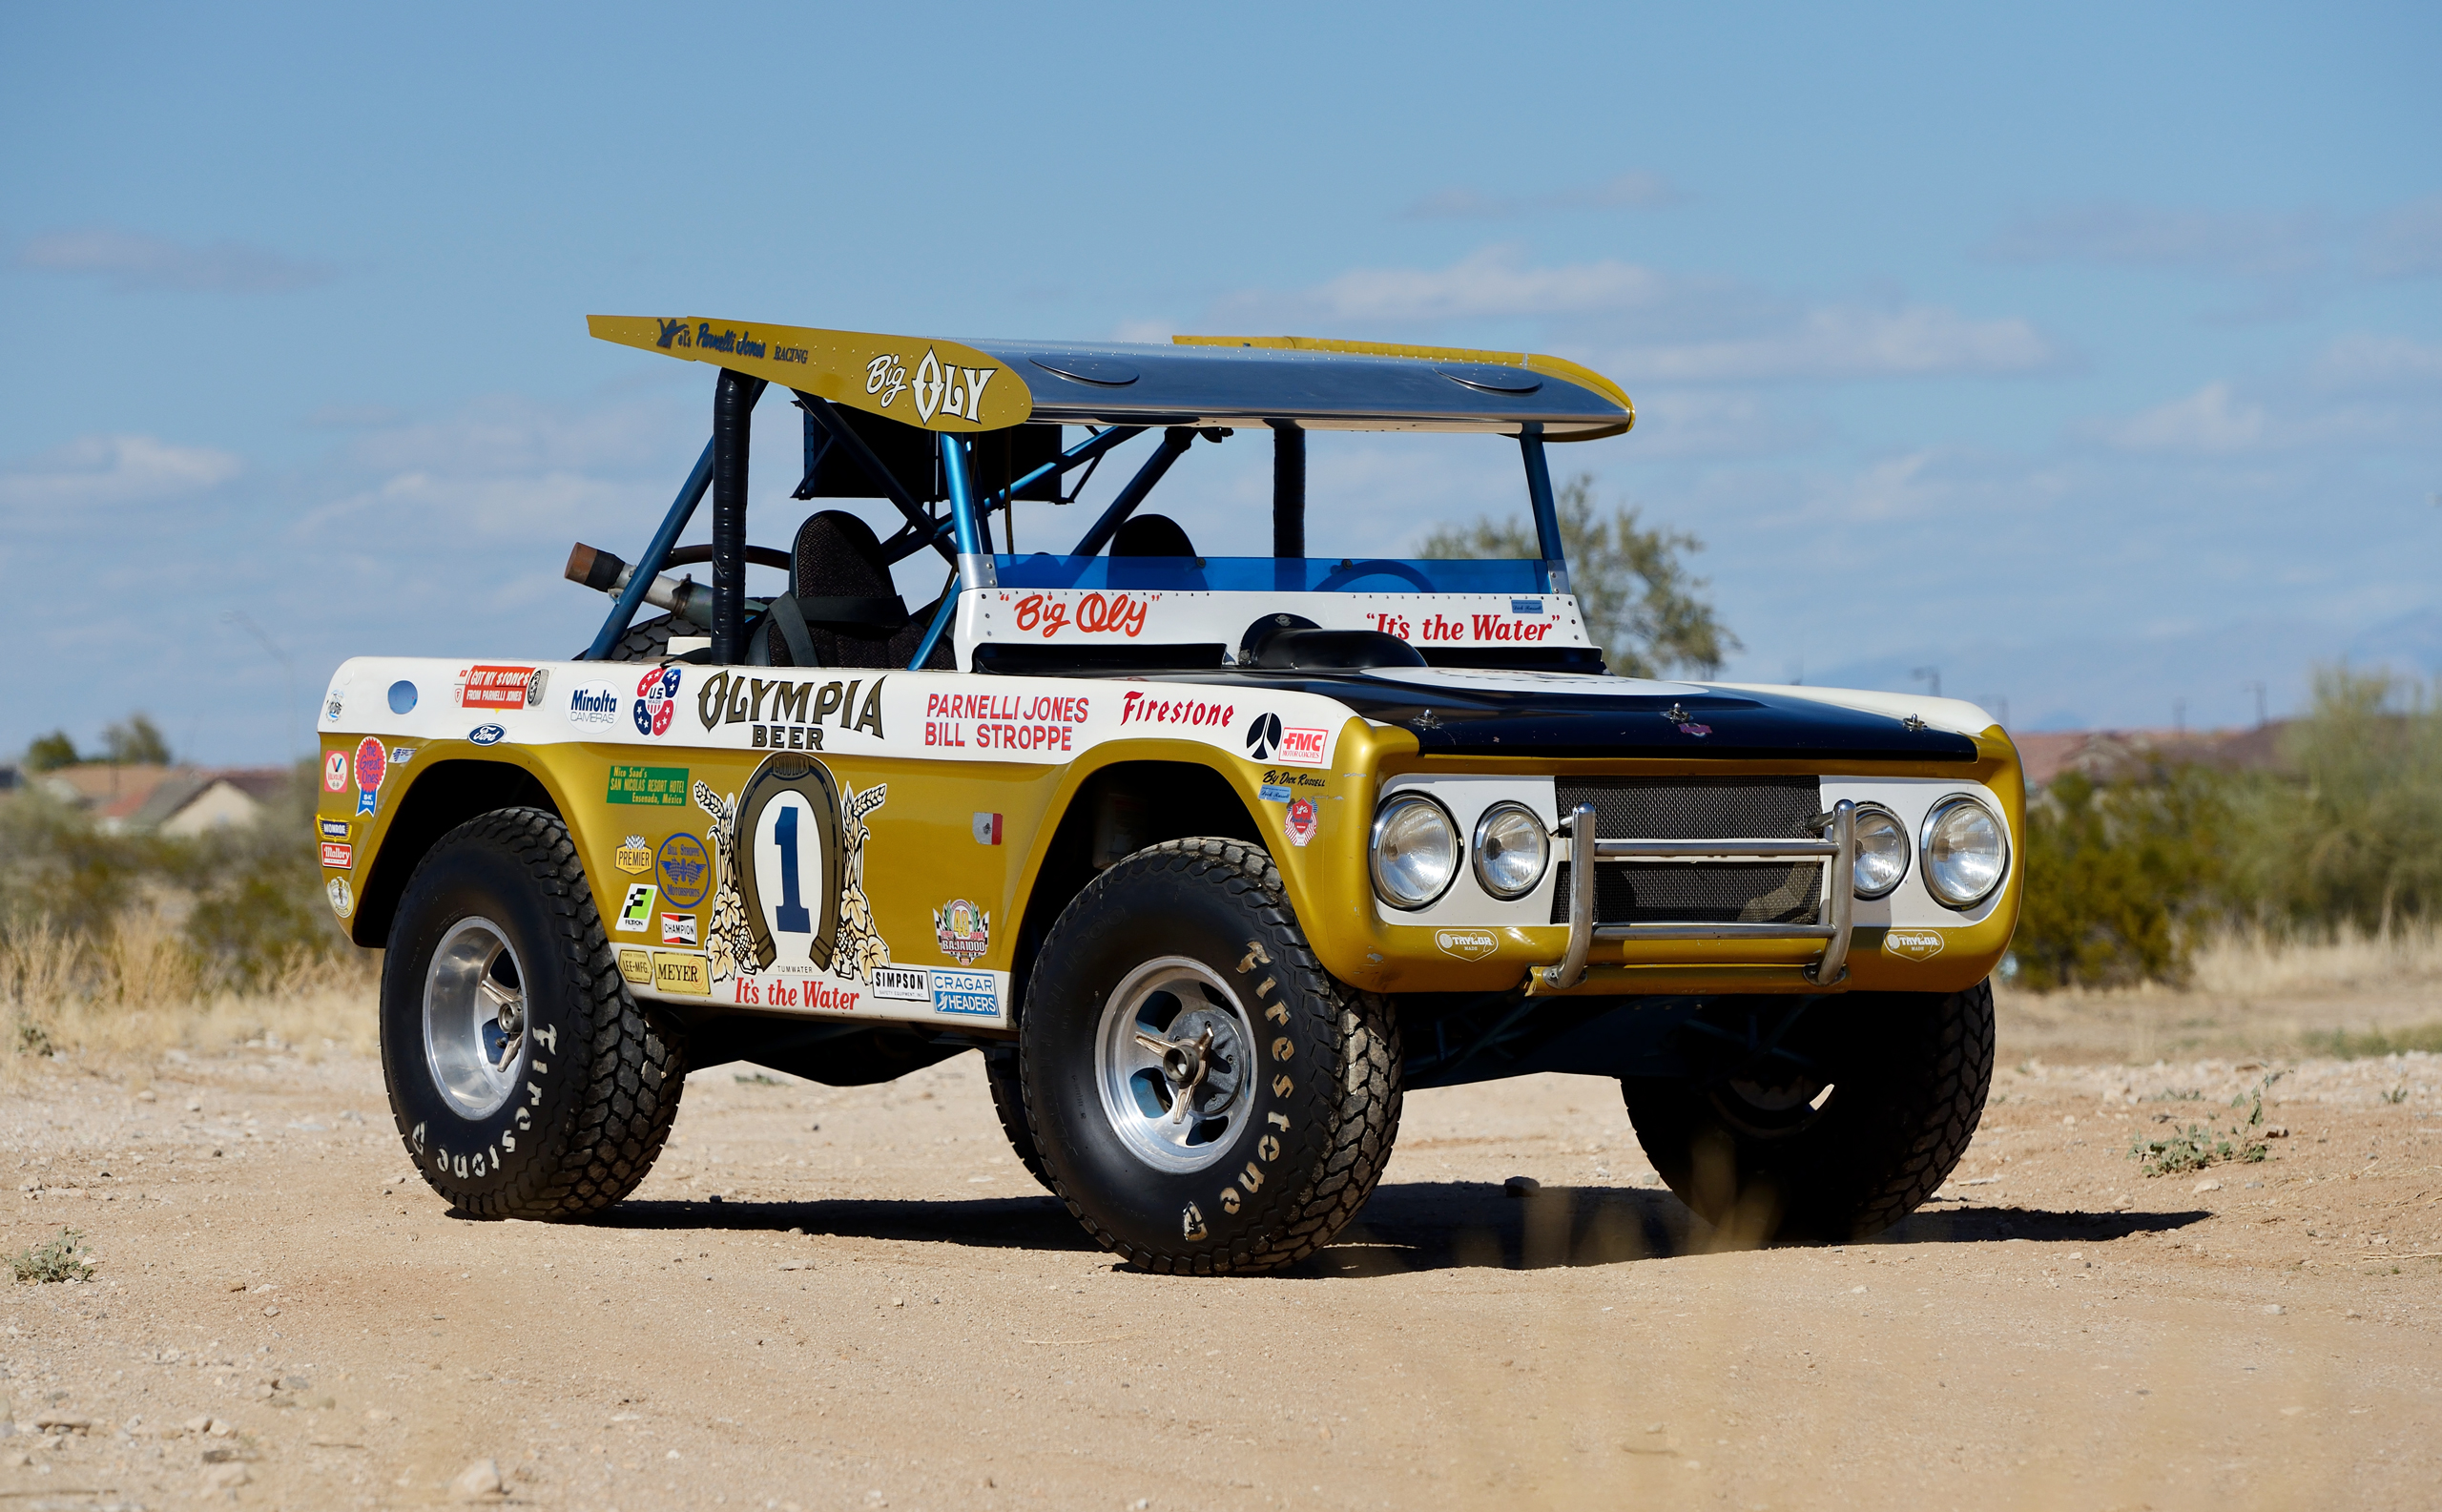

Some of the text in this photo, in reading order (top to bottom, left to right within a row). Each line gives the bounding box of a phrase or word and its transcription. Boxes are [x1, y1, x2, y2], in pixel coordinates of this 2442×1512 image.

[774, 345, 809, 364] RACING
[865, 344, 999, 426] Big OLY
[1422, 613, 1464, 641] the
[470, 671, 486, 686] GOT
[483, 672, 497, 686] MY
[466, 689, 523, 702] FROM PARNELLI JONES
[570, 689, 617, 713] Minolta
[697, 669, 889, 740] OLYMPIA
[926, 693, 1089, 723] PARNELLI JONES
[1120, 691, 1234, 728] Firestone
[570, 711, 614, 724] CAMERAS
[473, 726, 501, 741] Ford
[752, 724, 824, 751] BEER
[924, 721, 1072, 751] BILL STROPPE
[365, 741, 377, 757] the
[1283, 733, 1323, 752] FMC
[359, 755, 382, 771] Great
[1298, 750, 1320, 759] COACHES
[362, 770, 379, 784] Ones
[613, 766, 648, 778] Nico Saad's
[1262, 770, 1279, 784] By
[610, 777, 685, 794] SAN NICOLAS RESORT HOTEL
[632, 792, 682, 805] Ensenada, México
[323, 823, 346, 835] MONROE
[324, 845, 350, 860] Mallory
[618, 850, 650, 867] PREMIER
[774, 805, 811, 934] 1
[664, 923, 694, 935] CHAMPION
[954, 909, 970, 938] 40
[1452, 936, 1493, 946] TAYLOR
[1898, 936, 1939, 946] TAYLOR
[657, 963, 698, 983] MEYER
[876, 971, 923, 990] SIMPSON
[934, 976, 993, 992] CRAGAR
[735, 977, 859, 1010] It's the Water
[948, 994, 996, 1012] HEADERS
[1219, 941, 1295, 1214] Firestone
